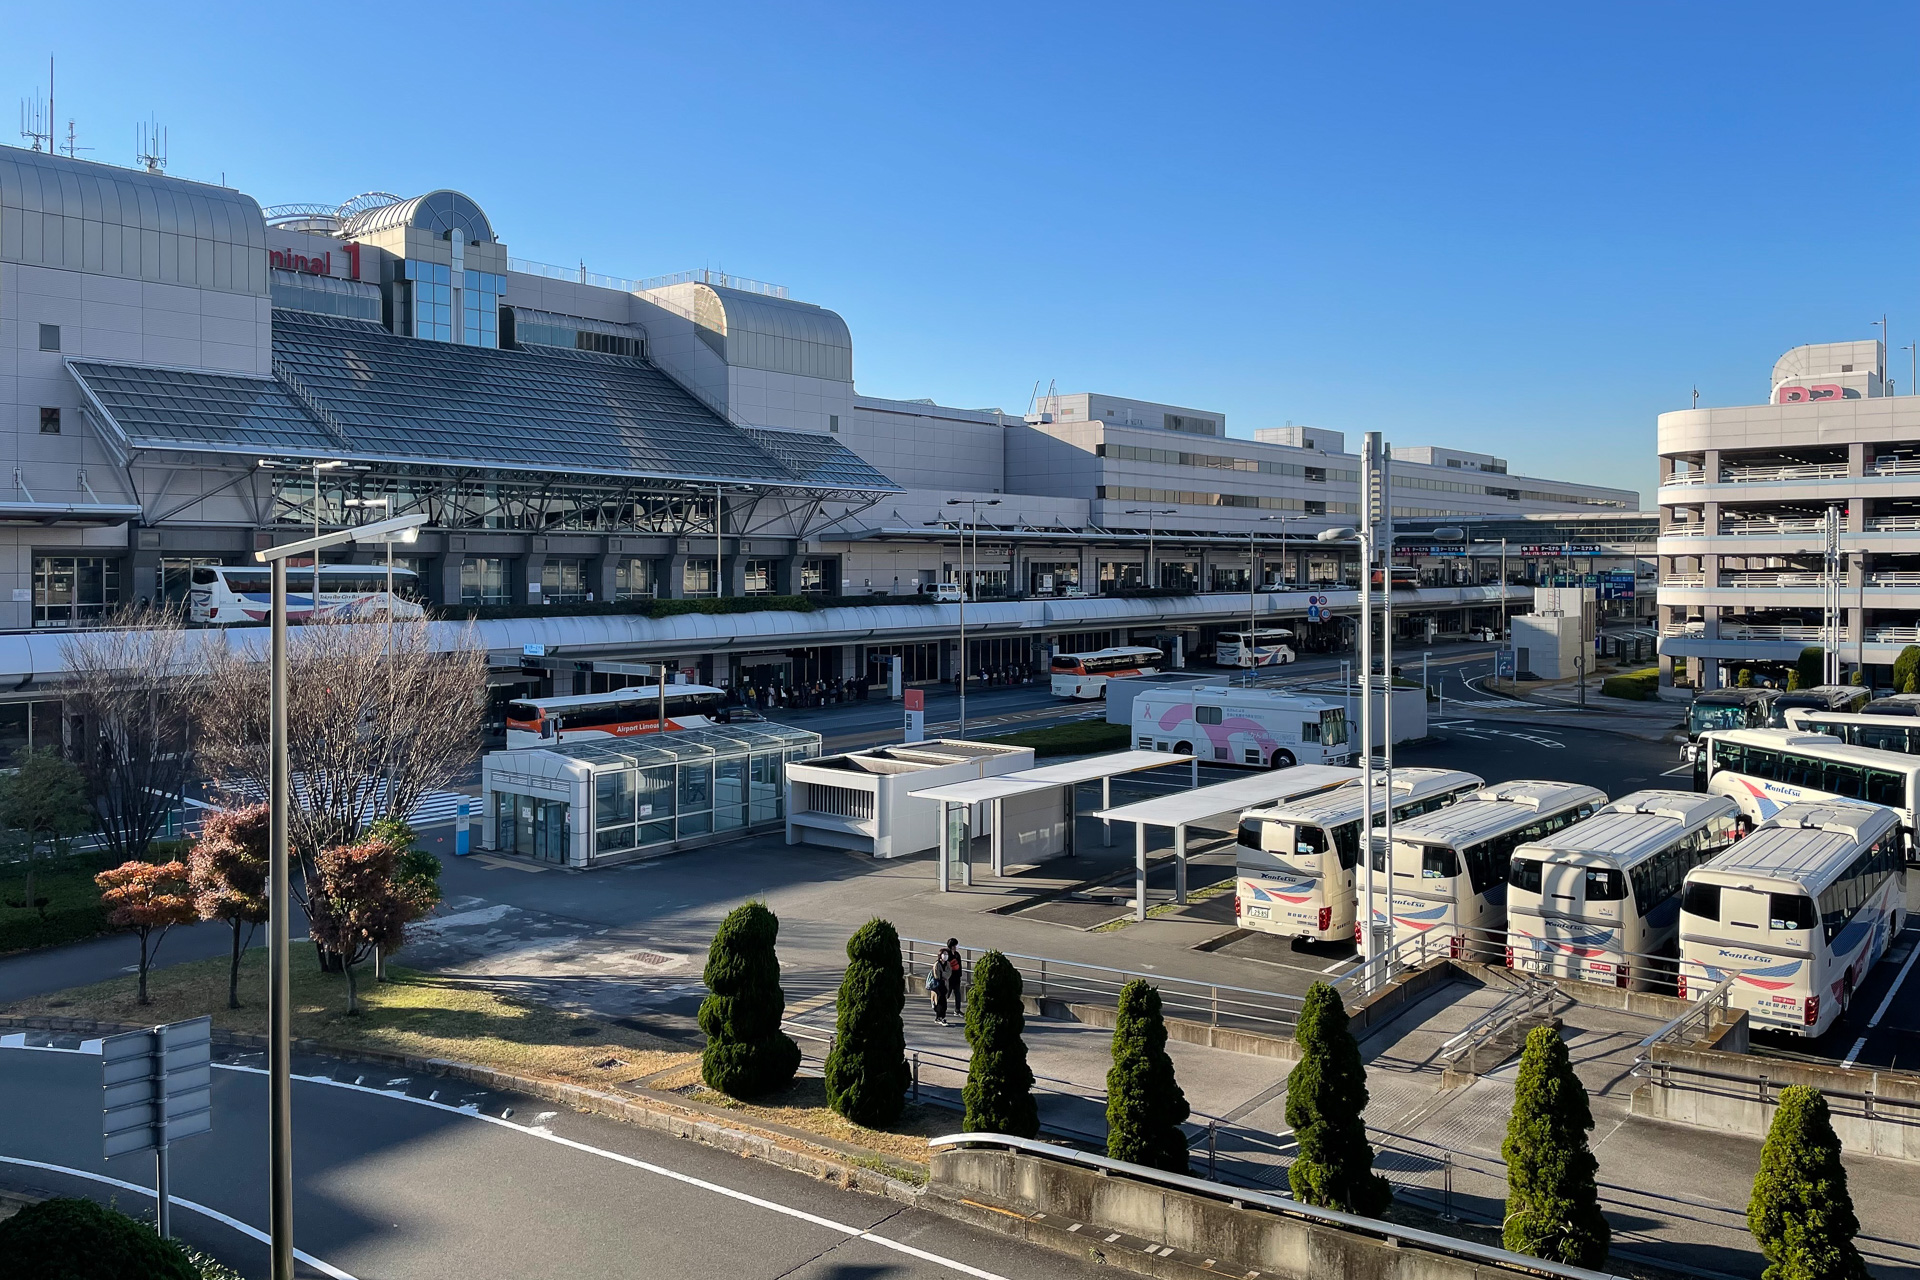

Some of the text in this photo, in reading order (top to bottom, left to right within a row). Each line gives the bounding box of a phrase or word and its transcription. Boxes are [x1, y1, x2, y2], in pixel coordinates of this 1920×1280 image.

[342, 241, 360, 279] 1
[616, 721, 669, 734] Airport Limouse
[1764, 782, 1801, 798] Kantetsu
[1261, 872, 1297, 883] Kantetsu
[1545, 920, 1584, 931] Kantetsu
[1718, 949, 1773, 964] Kantetsu
